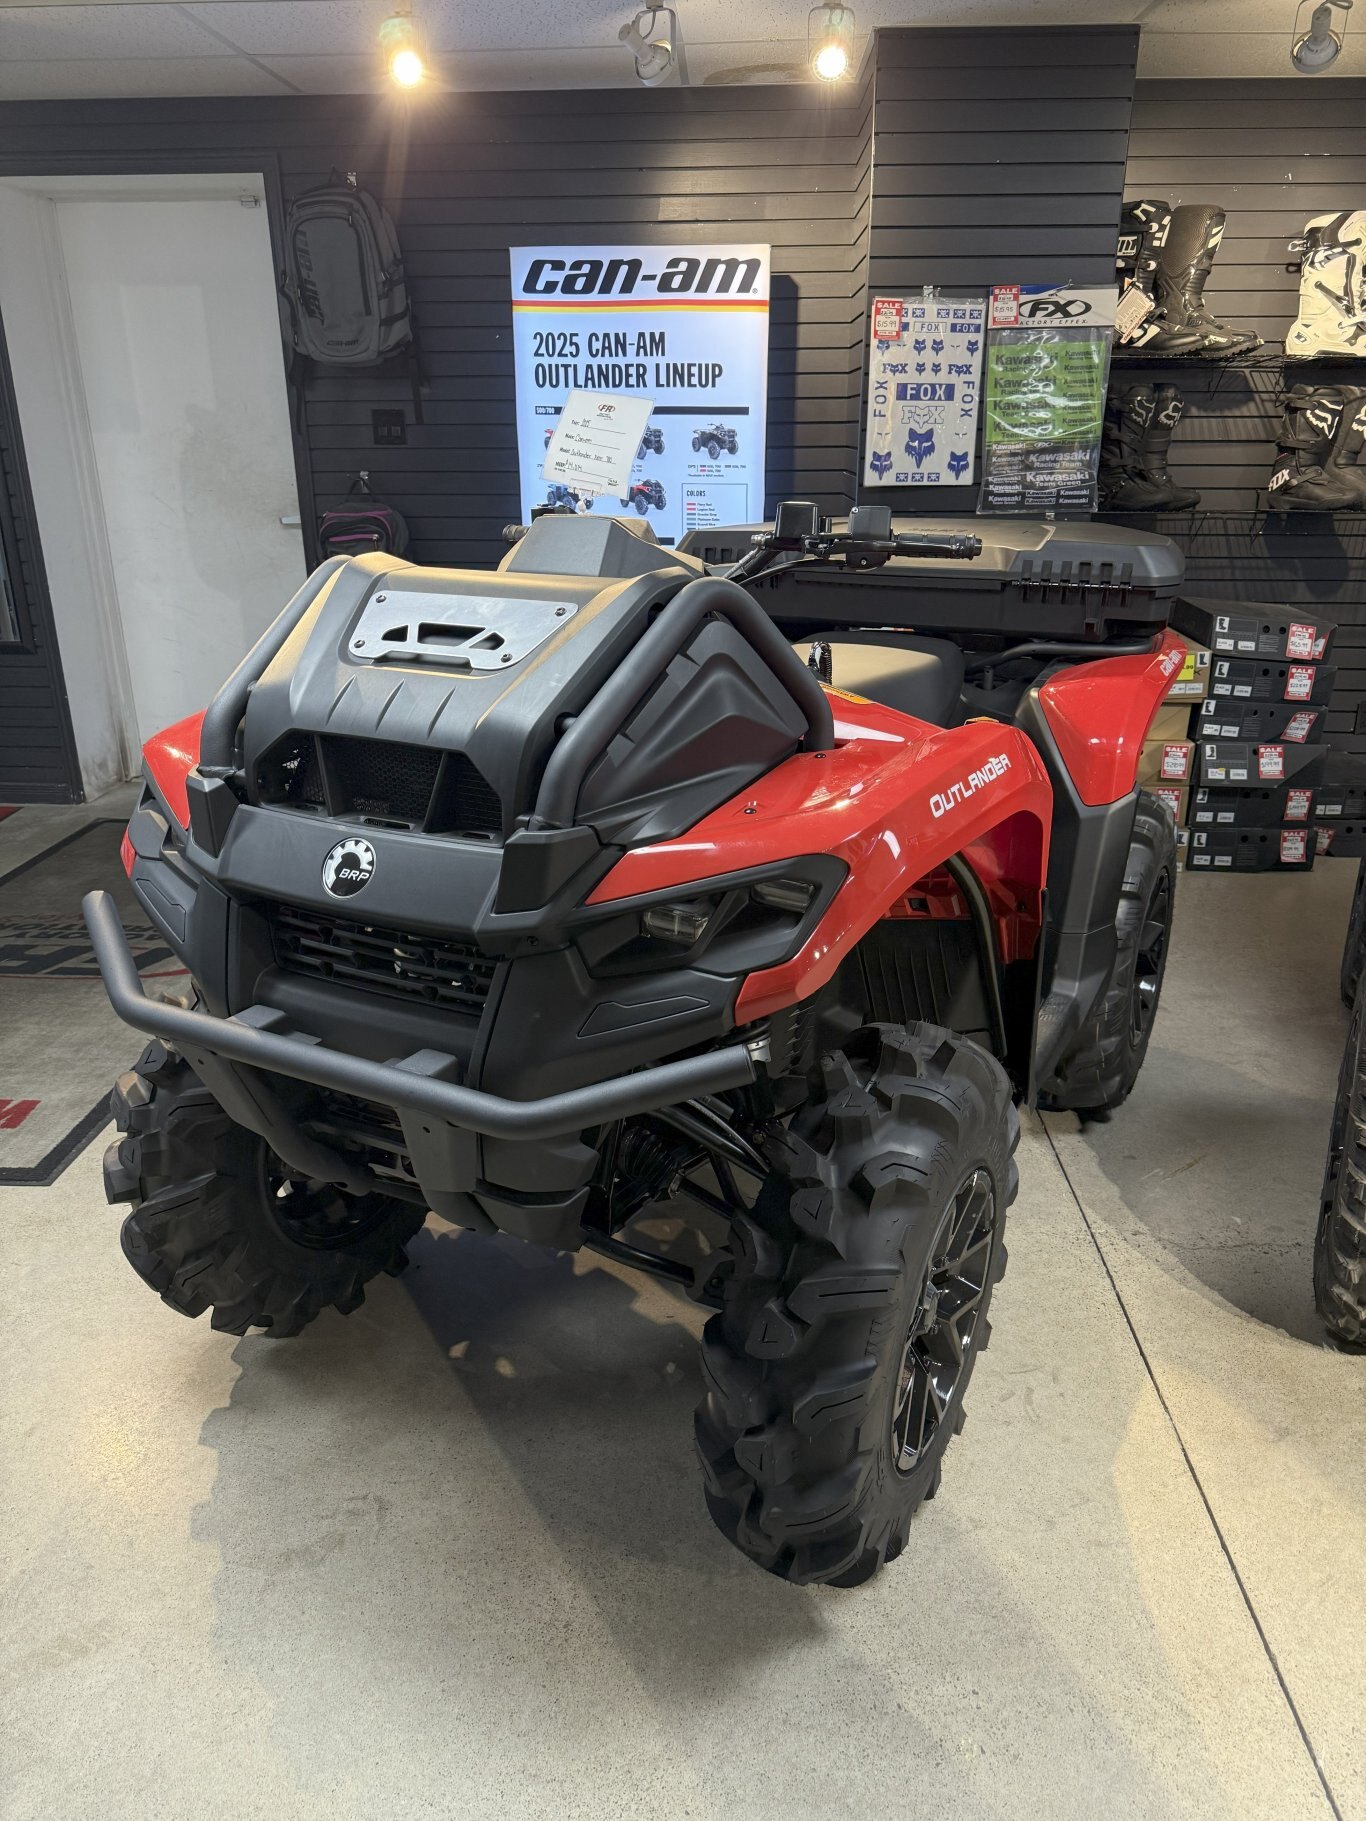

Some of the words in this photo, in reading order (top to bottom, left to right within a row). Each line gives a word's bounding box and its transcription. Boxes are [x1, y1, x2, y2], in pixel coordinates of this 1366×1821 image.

[522, 257, 762, 295] can-am
[920, 323, 940, 332] FOX
[956, 325, 975, 333] FOX
[533, 331, 580, 358] 2025
[588, 331, 666, 358] CAN-AM
[534, 363, 648, 389] OUTLANDER
[656, 363, 723, 388] LINEUP
[873, 380, 888, 418] FOX
[906, 384, 947, 401] FOX
[960, 380, 975, 418] FOX
[992, 442, 1026, 450] Kawasaki
[1029, 450, 1091, 462] Kawasaki
[1026, 471, 1089, 482] Kawasaki
[1292, 626, 1314, 634] SALE
[929, 753, 1012, 818] OUTLANDER
[339, 868, 370, 882] BRP
